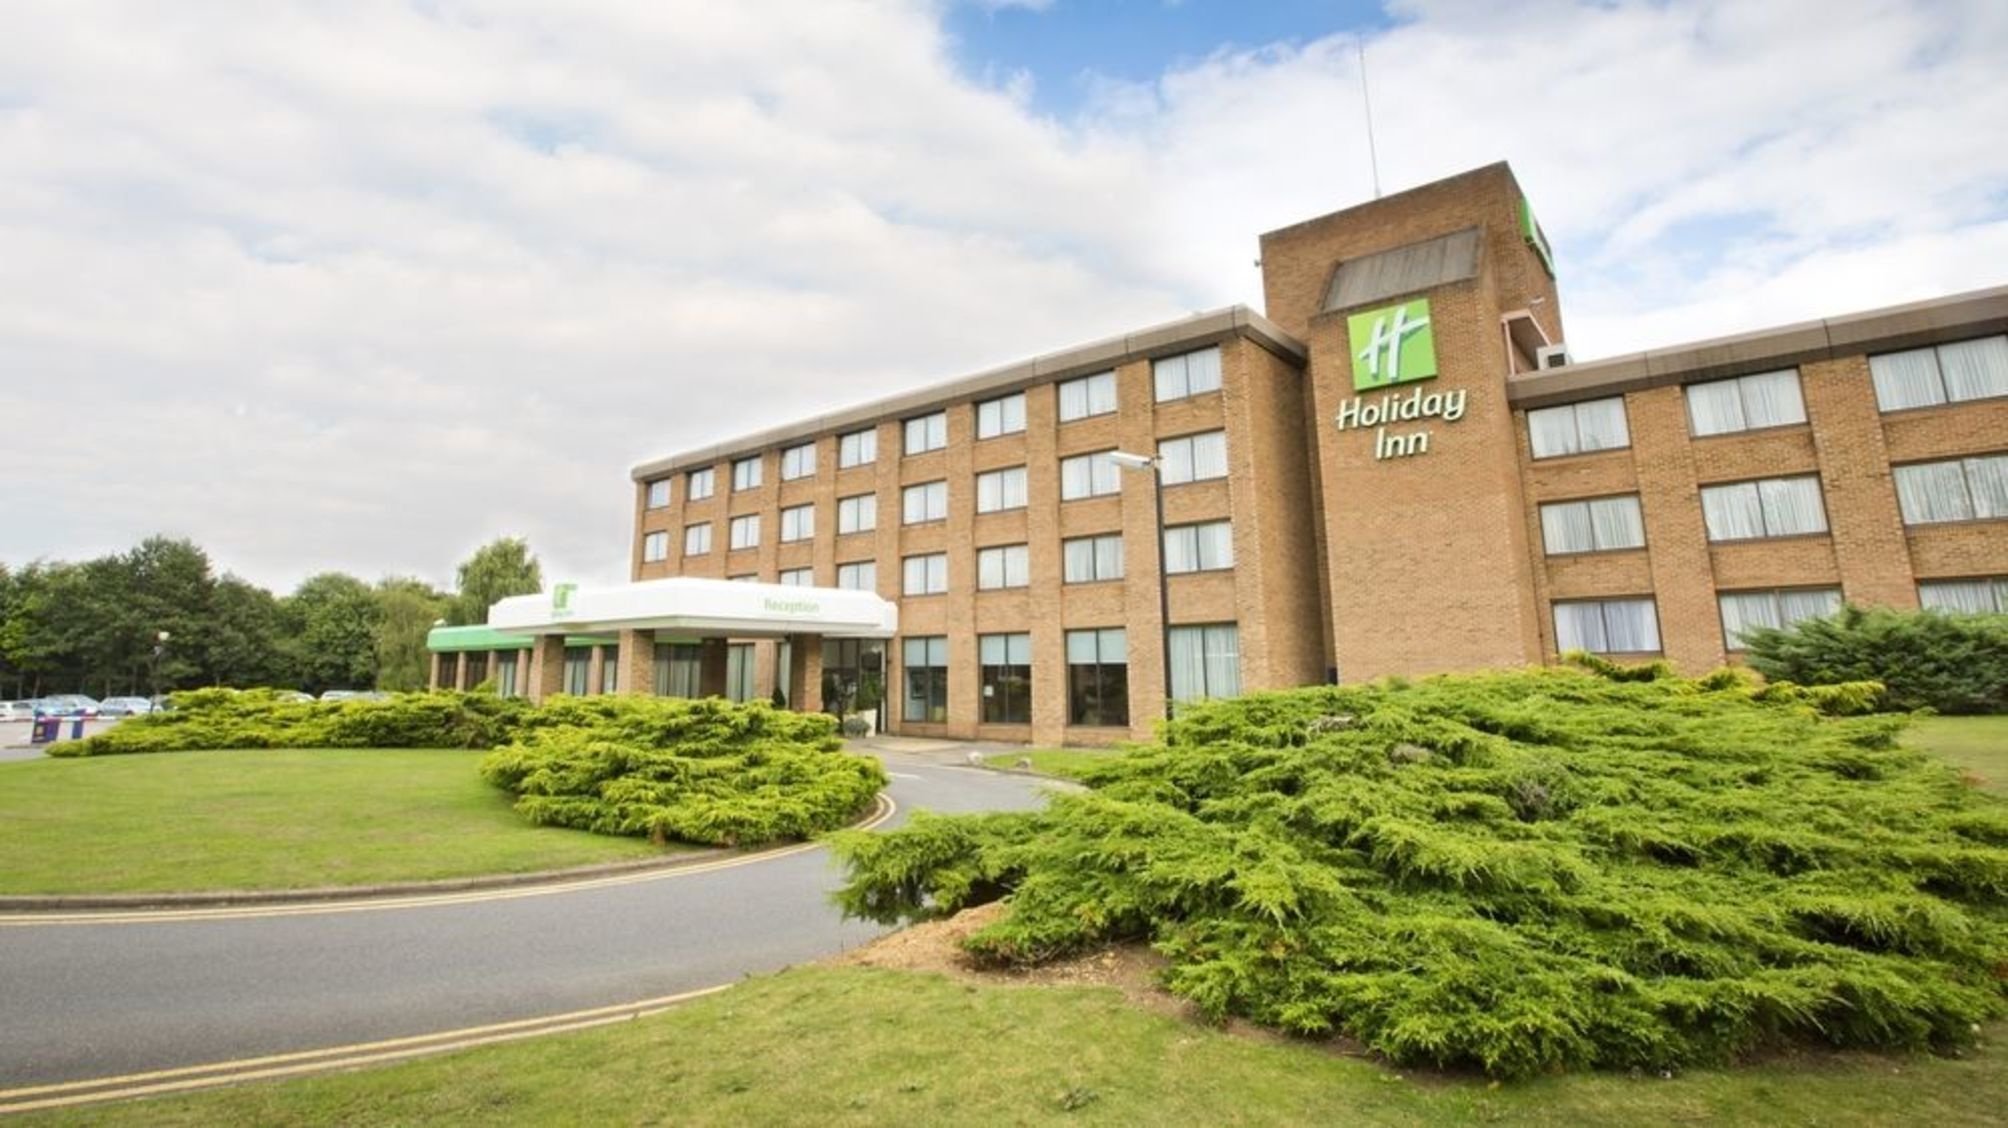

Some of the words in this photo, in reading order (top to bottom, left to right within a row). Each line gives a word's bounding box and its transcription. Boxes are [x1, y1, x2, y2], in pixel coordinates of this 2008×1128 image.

[1336, 387, 1467, 431] Holiday
[1375, 427, 1429, 460] Inn
[763, 597, 820, 615] Reception
